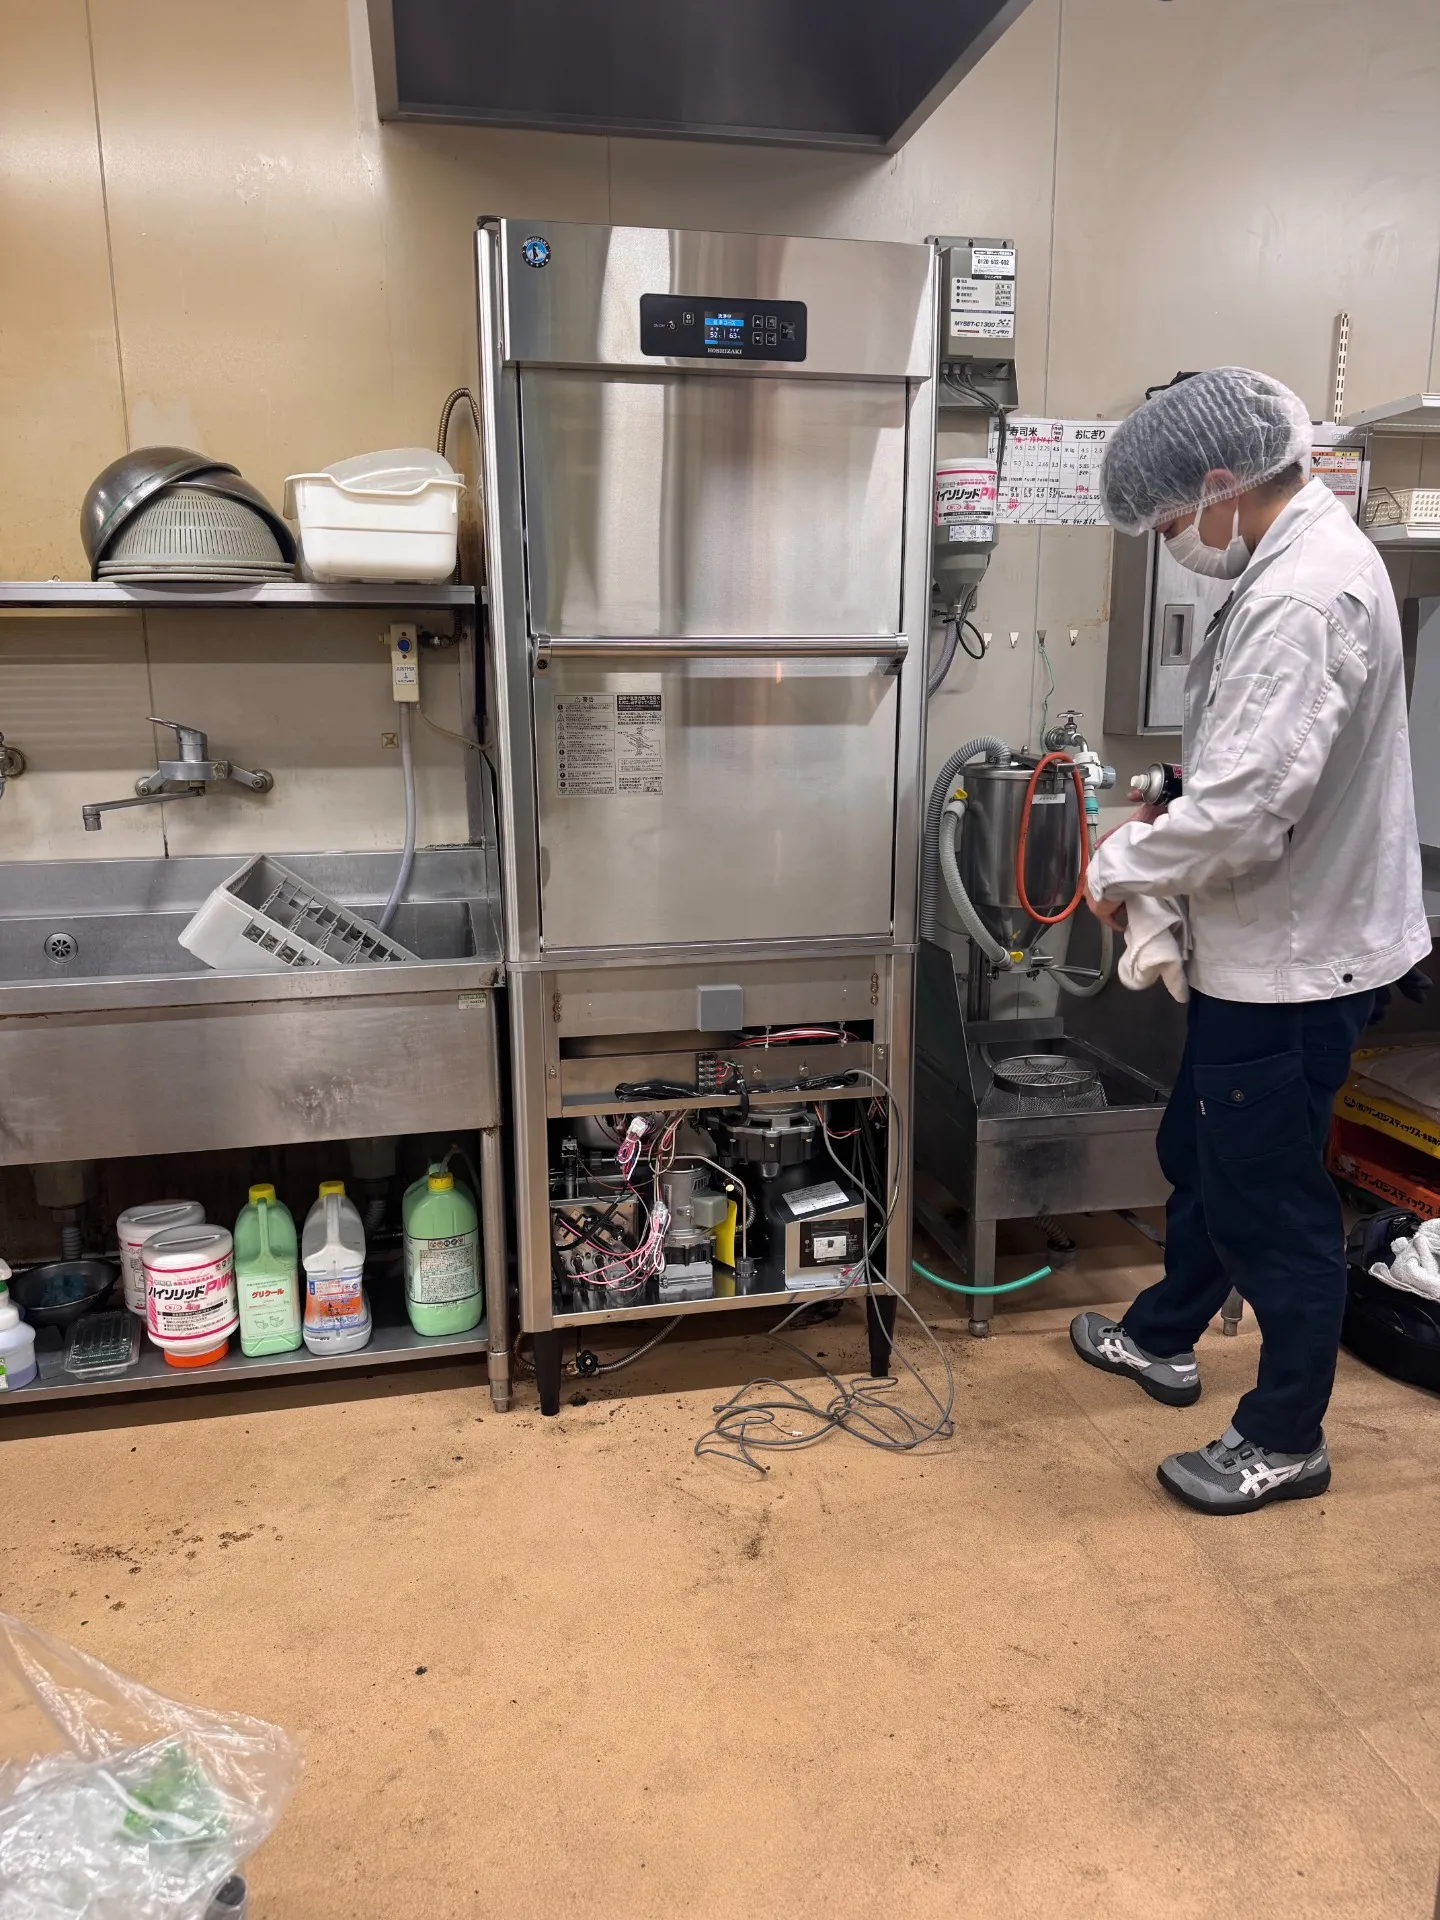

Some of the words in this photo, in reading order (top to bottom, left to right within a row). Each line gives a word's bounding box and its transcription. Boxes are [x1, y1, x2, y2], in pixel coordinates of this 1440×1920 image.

[1009, 426, 1038, 436] 寿司米
[1075, 430, 1106, 440] おにぎり
